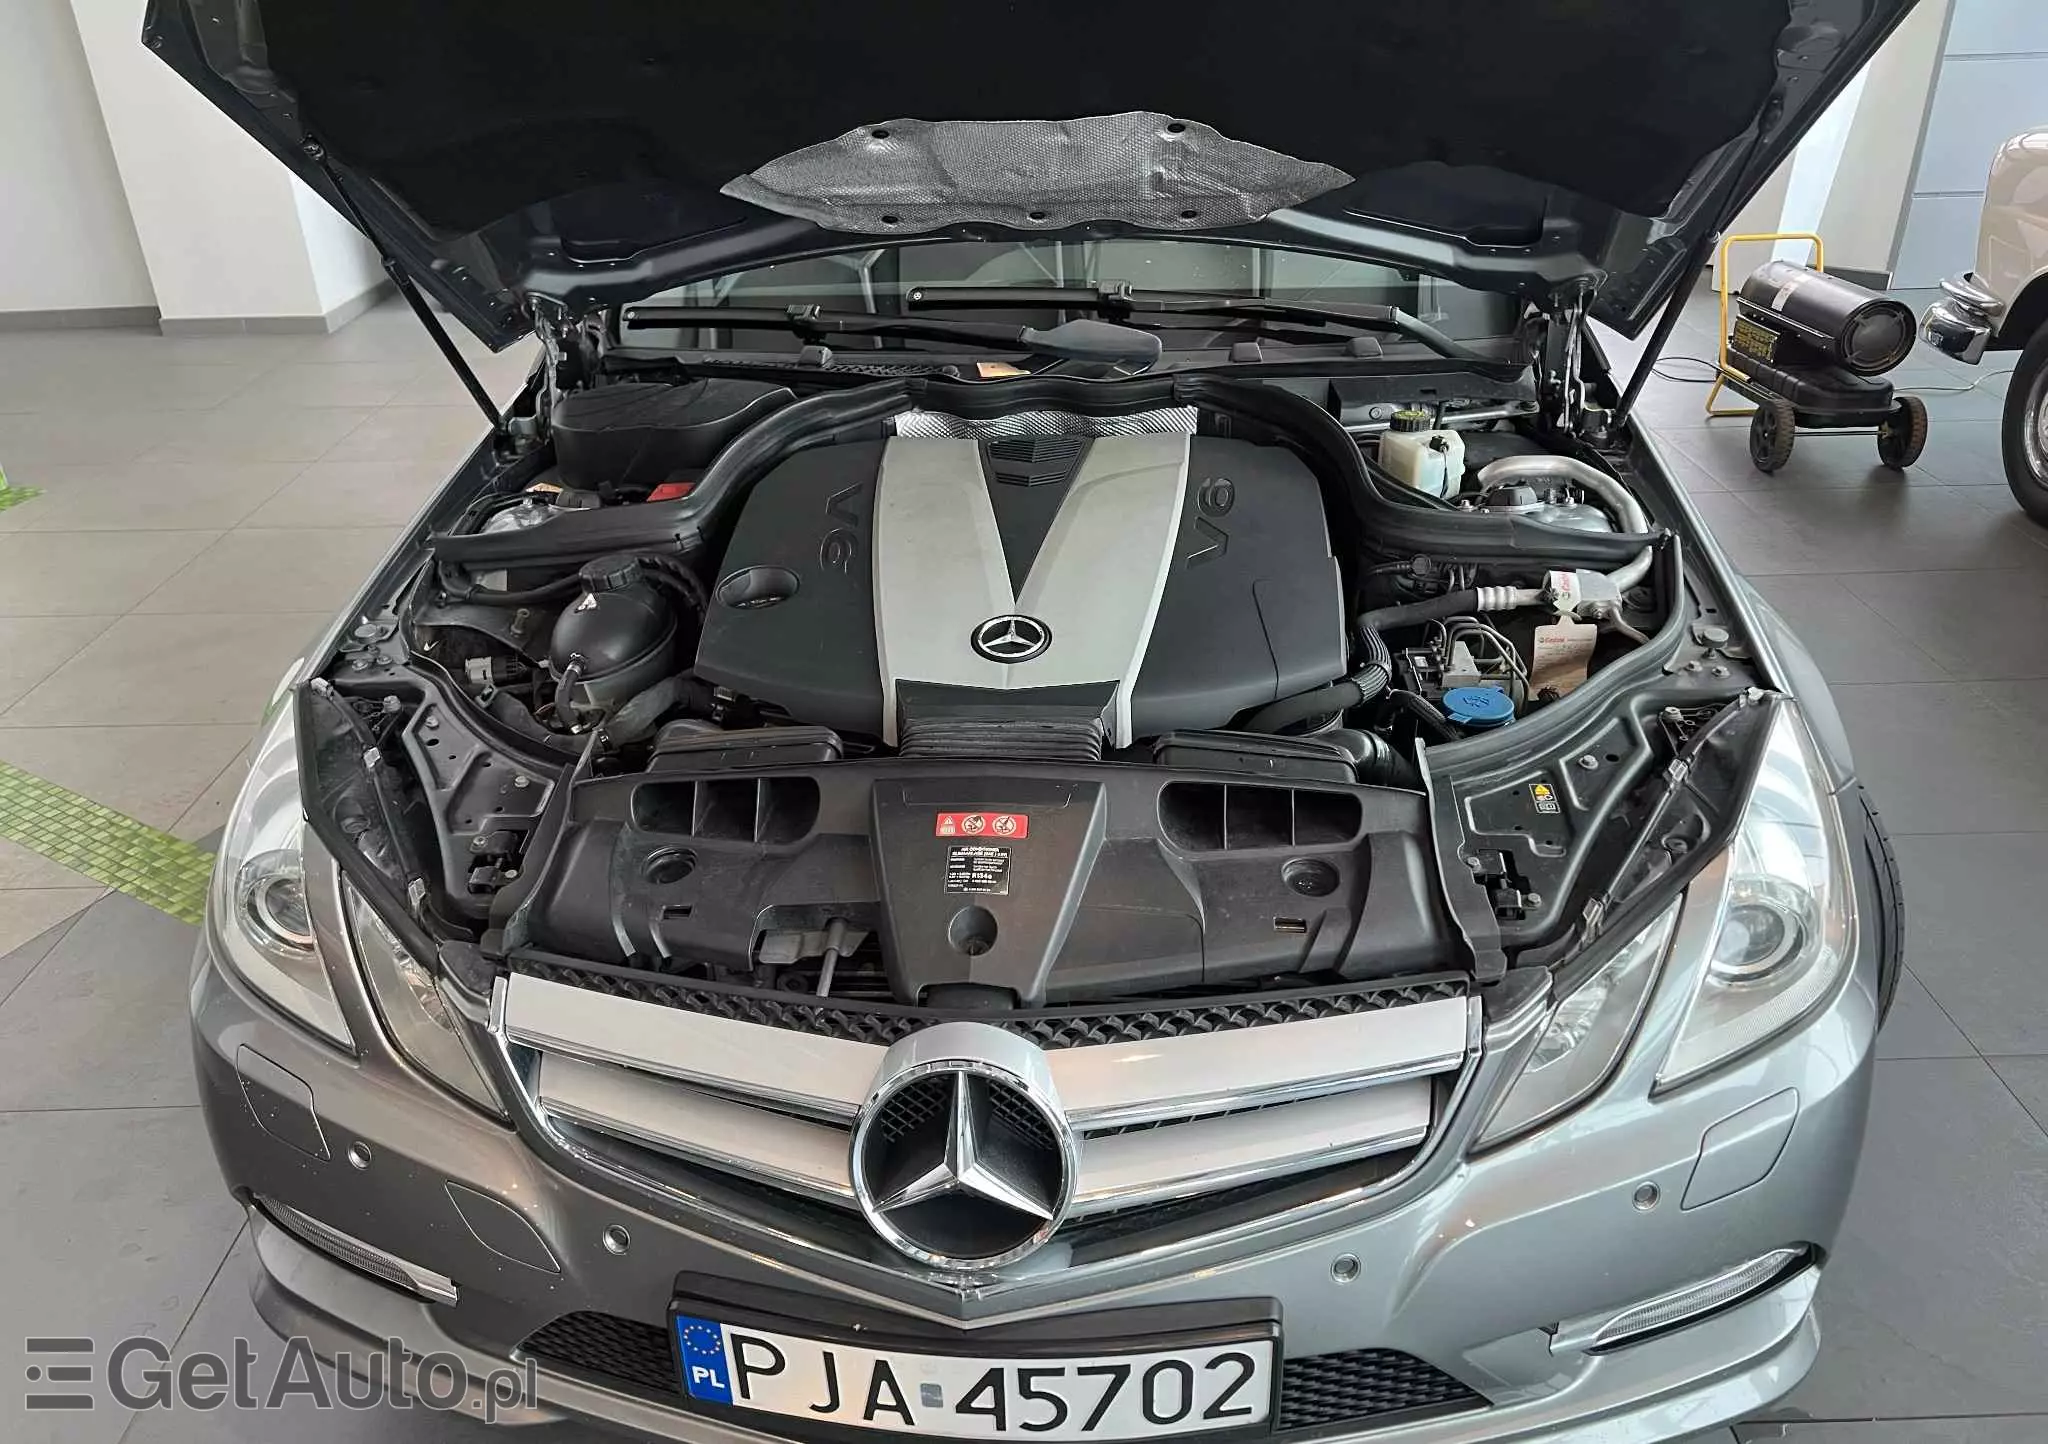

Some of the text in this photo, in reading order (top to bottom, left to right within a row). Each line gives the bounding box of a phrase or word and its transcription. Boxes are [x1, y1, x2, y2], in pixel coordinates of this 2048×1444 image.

[820, 481, 864, 574] V6
[1185, 477, 1236, 570] V6
[692, 1364, 725, 1389] PL
[729, 1332, 1255, 1432] PJA 45702
